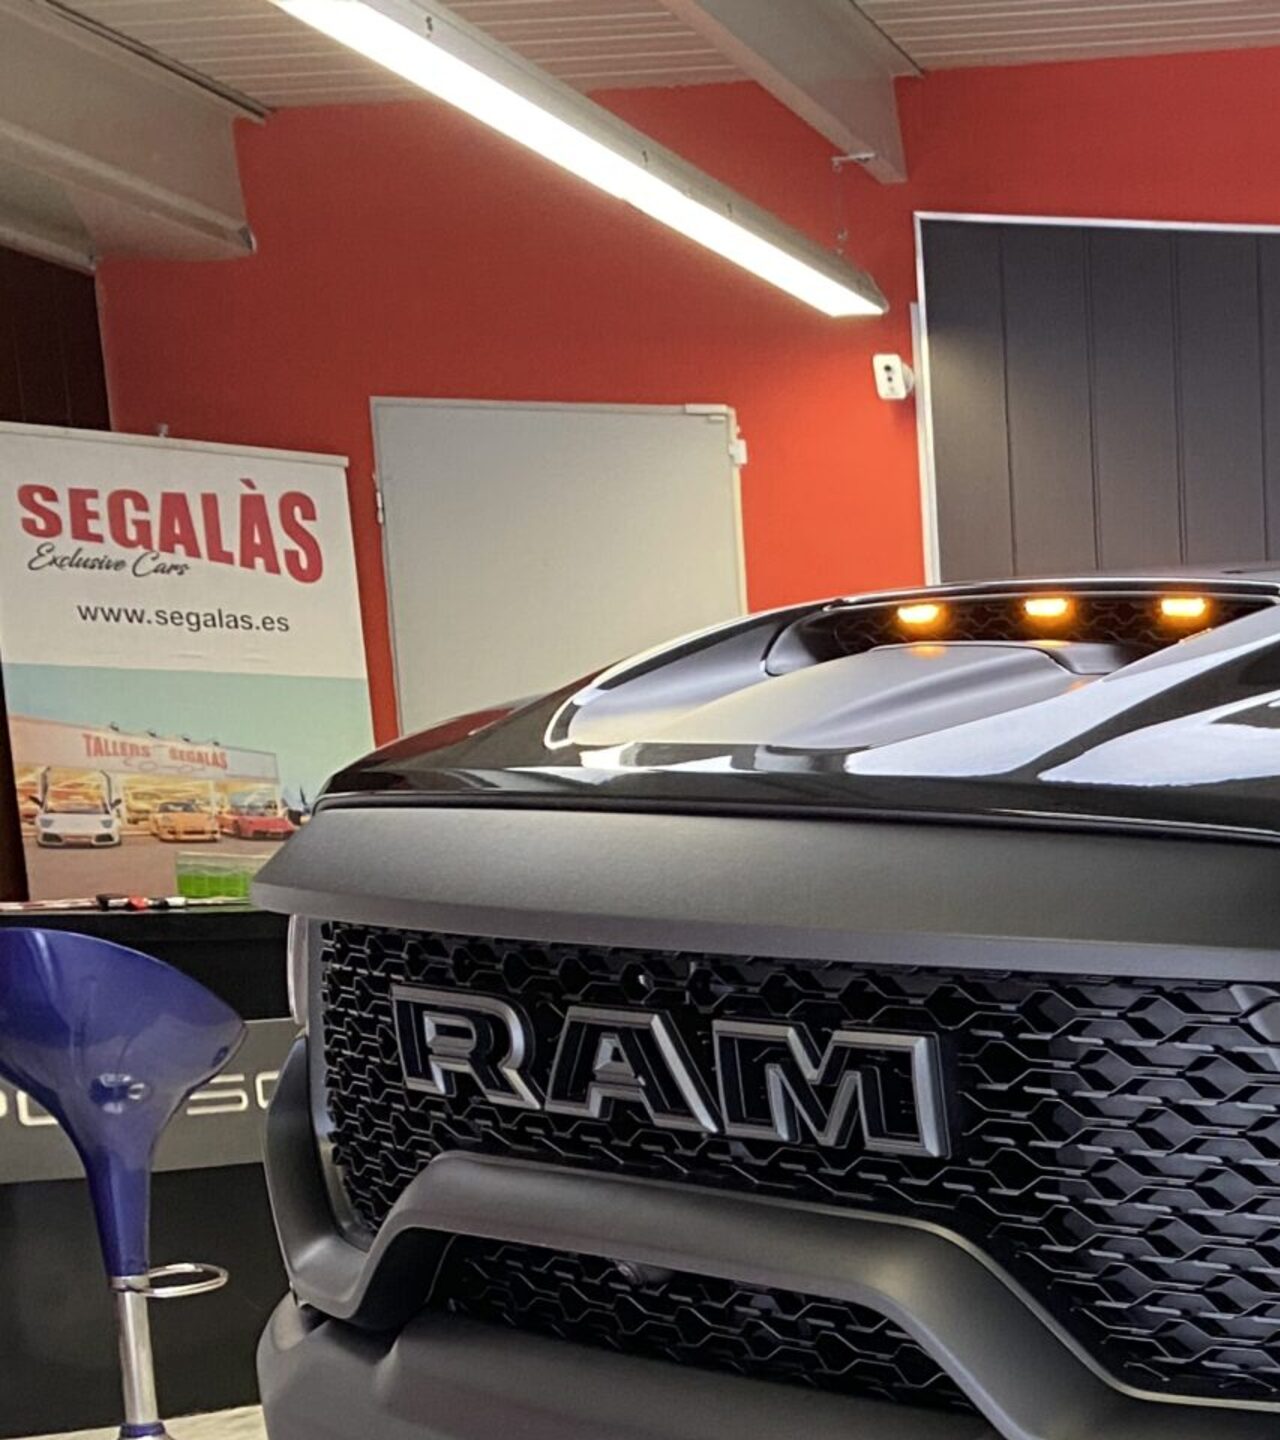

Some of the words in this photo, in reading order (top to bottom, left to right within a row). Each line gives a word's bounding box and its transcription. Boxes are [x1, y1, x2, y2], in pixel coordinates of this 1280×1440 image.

[17, 478, 323, 584] SEGALÀS
[27, 543, 126, 575] Exclusive
[132, 551, 190, 578] Cars
[77, 603, 290, 632] www.segalas.es
[83, 734, 151, 758] TALLERS
[390, 982, 952, 1159] RAM
